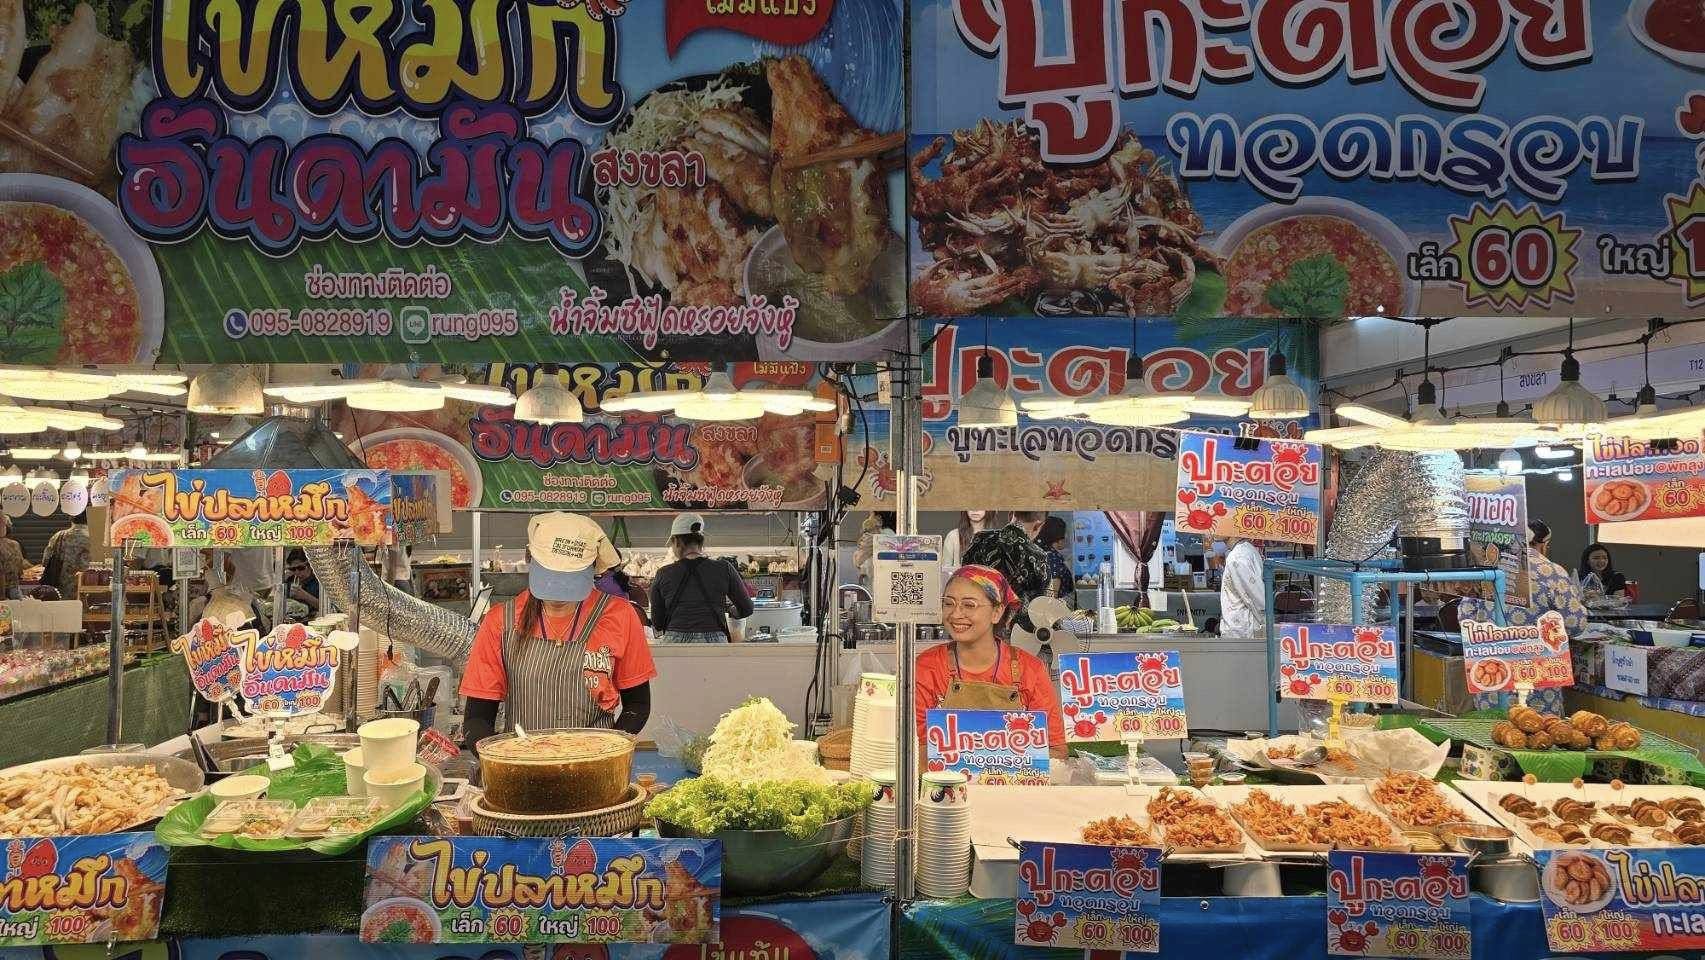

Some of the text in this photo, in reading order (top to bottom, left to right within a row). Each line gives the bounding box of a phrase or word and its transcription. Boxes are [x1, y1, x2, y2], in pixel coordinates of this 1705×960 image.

[1167, 112, 1644, 200] ทอดกรอบ
[119, 101, 597, 250] อันดามัน
[592, 150, 706, 187] สงขลา
[1408, 242, 1461, 280] เล็ก
[1470, 225, 1557, 289] 60
[1597, 233, 1673, 280] ใหญ่
[305, 263, 452, 299] ช่องทางติดต่อ
[250, 308, 392, 336] 095-0828919
[431, 309, 518, 342] rung095
[1519, 373, 1547, 388] สงขลา
[702, 424, 758, 442] สงขลา
[142, 470, 349, 521] ไข่ปลาหมึก
[1220, 485, 1299, 507] ทอดกรอบ
[1663, 489, 1691, 507] 60
[181, 523, 207, 541] เล็ก
[250, 525, 282, 542] ใหญ่
[288, 525, 316, 541] 100
[1241, 513, 1313, 535] 60 100
[229, 629, 339, 673] ไข่หมึก
[1520, 666, 1568, 680] 60 100
[1334, 683, 1393, 697] 60 100
[1121, 718, 1181, 732] 60 100
[409, 838, 668, 910] ไข่ปลาหมึก
[1605, 849, 1705, 908] ไข่ปล
[1060, 895, 1141, 913] ทอดกรอบ
[1369, 905, 1449, 922] ทอดกรอบ
[51, 914, 87, 936] 100
[452, 911, 621, 937] เล็ก 60 ใหญ่ 100
[1083, 922, 1153, 943] 60 100
[1556, 921, 1634, 942] 60 100
[1395, 931, 1465, 950] 60 100
